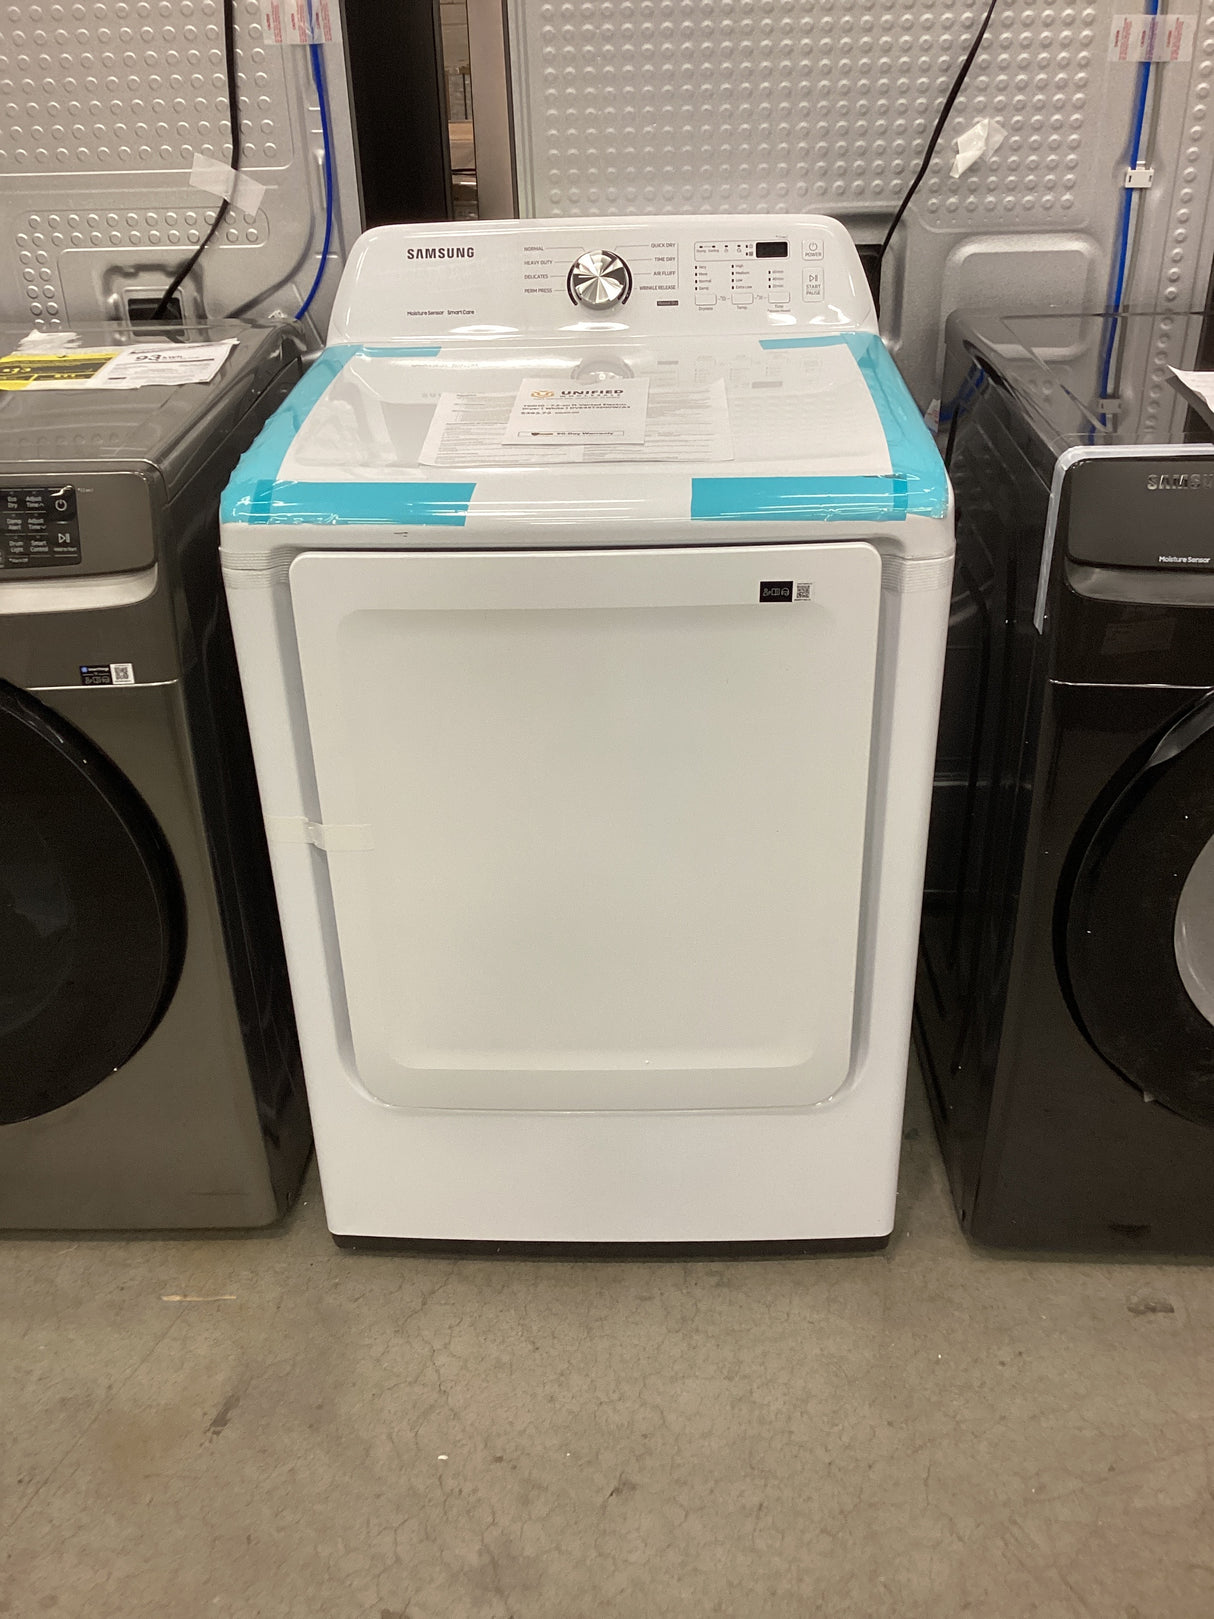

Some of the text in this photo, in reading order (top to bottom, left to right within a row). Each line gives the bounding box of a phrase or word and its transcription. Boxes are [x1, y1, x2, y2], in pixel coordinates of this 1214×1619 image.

[407, 247, 475, 260] SAMSUNG
[10, 546, 24, 554] Light
[1187, 556, 1211, 564] Sensor
